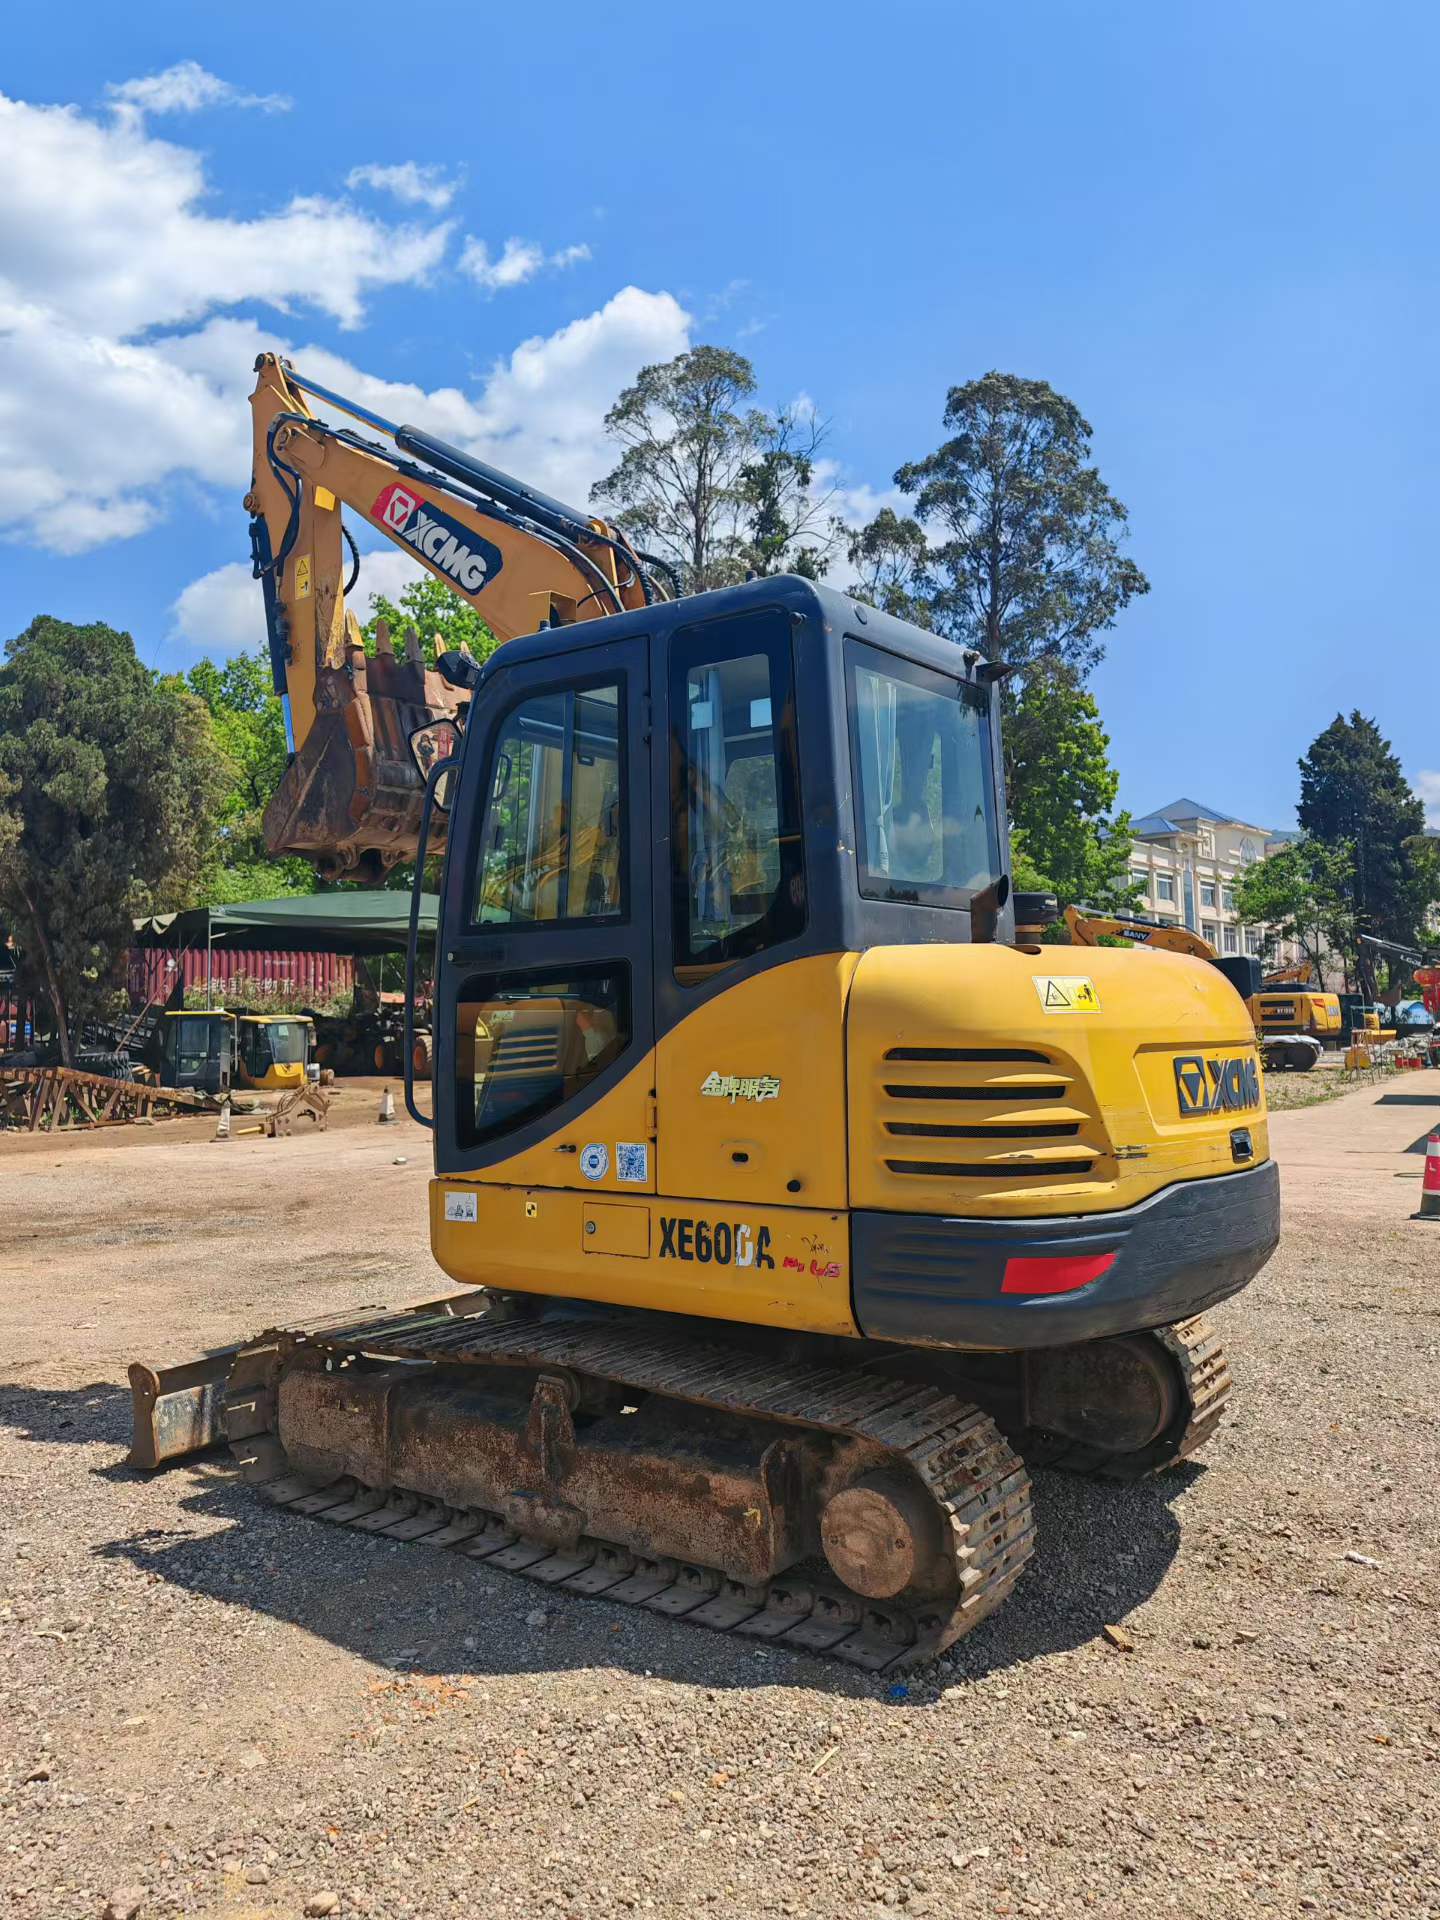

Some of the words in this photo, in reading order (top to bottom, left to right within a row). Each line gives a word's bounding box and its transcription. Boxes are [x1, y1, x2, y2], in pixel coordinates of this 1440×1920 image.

[401, 509, 487, 590] XCMG
[1123, 930, 1147, 940] SANY
[700, 1071, 780, 1104] 金牌服务
[1206, 1058, 1260, 1112] XCMG
